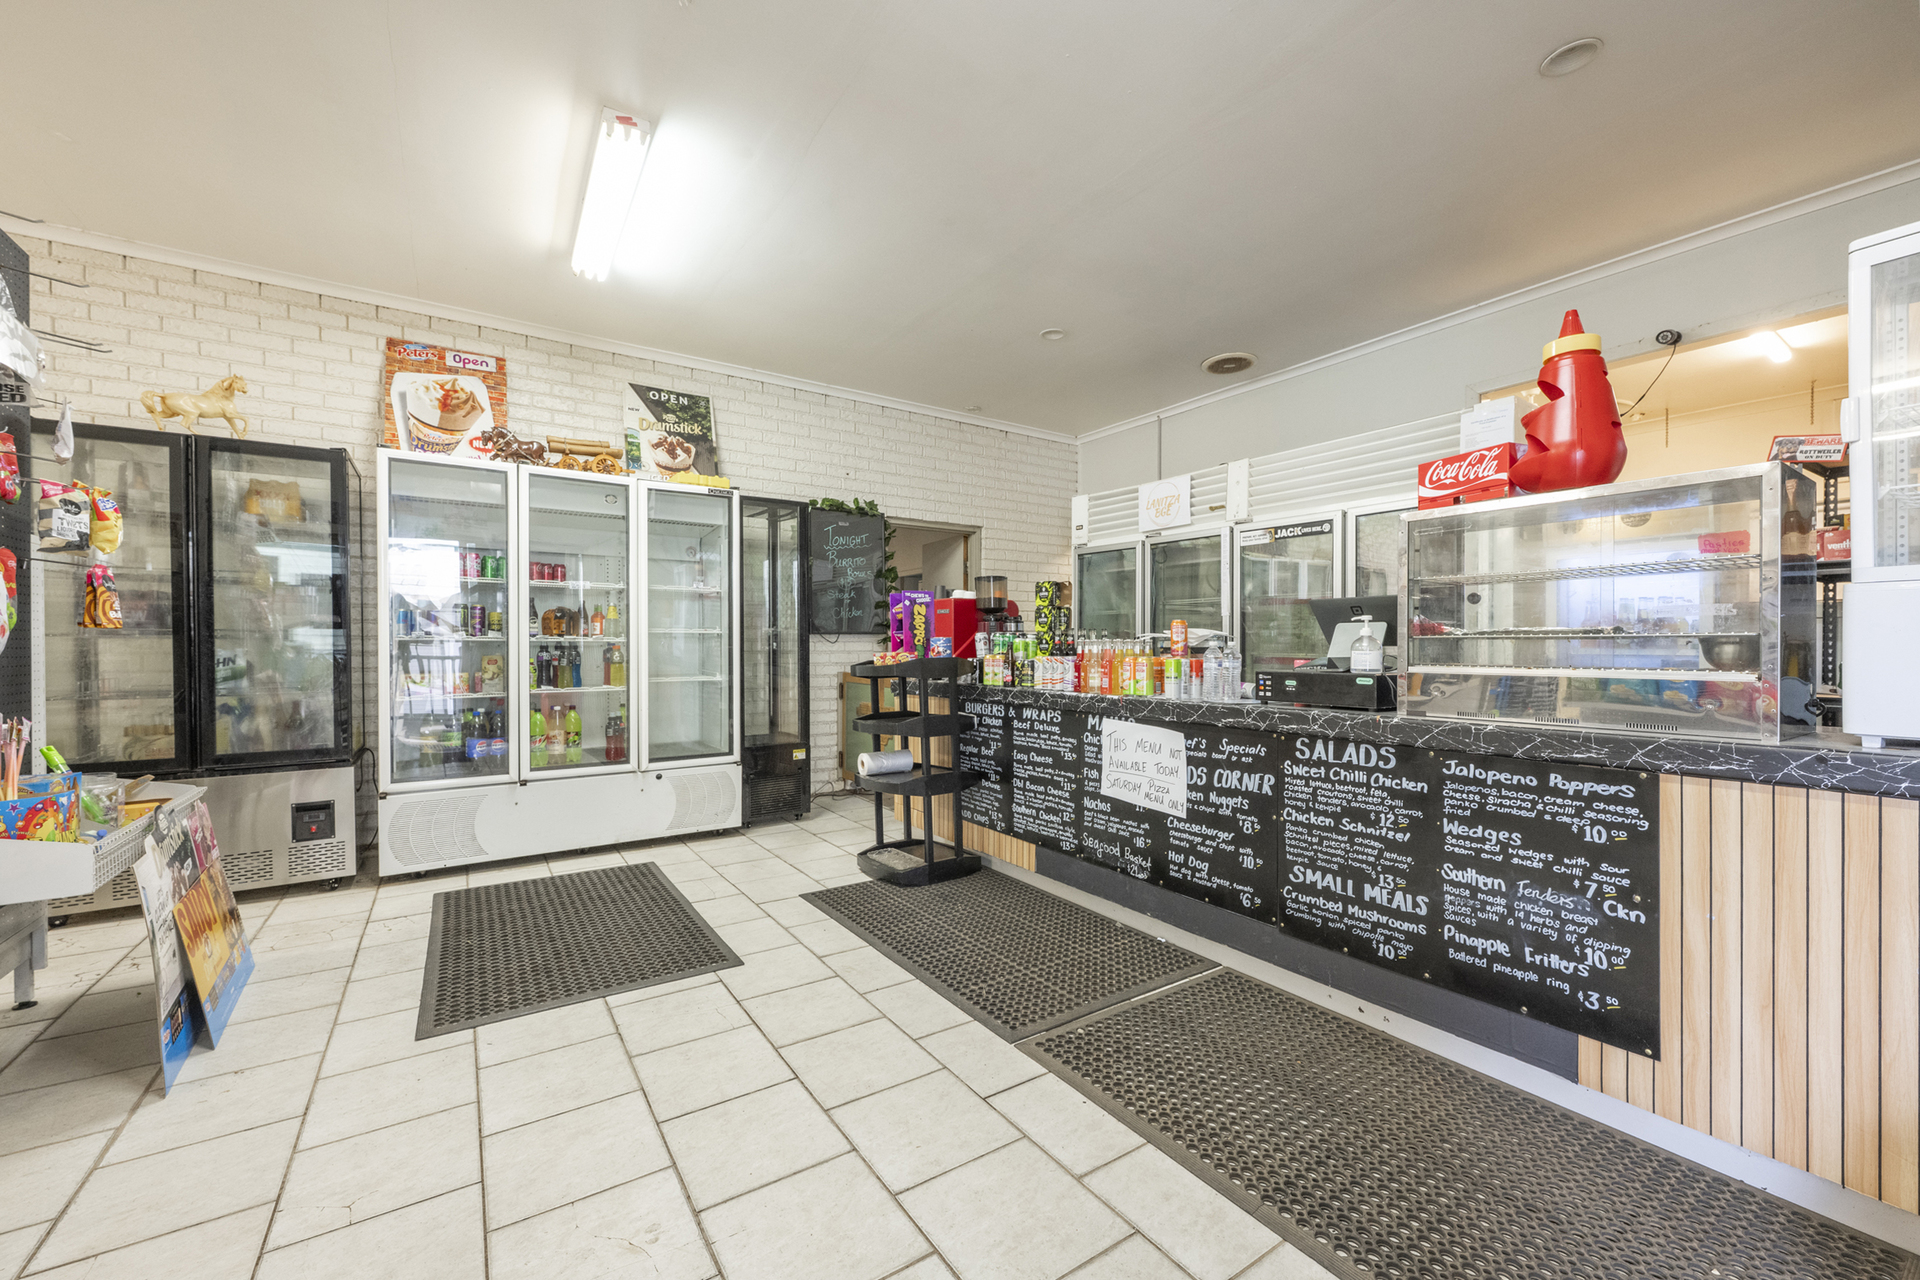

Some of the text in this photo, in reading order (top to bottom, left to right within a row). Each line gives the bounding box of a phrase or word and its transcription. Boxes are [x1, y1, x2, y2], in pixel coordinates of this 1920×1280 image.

[396, 346, 438, 358] Peters
[453, 354, 488, 368] Open
[649, 390, 688, 406] OPEN
[638, 417, 702, 434] Drumstick
[1804, 438, 1844, 446] BEWARE
[1425, 446, 1504, 488] Coca-Cola
[824, 524, 869, 546] TONIGHT
[1275, 526, 1302, 538] JACK
[1703, 538, 1745, 548] Pasties
[826, 550, 866, 568] BURRITO
[827, 590, 856, 599] Steak
[832, 606, 863, 618] Chicken
[965, 701, 1062, 722] BURGERS & WRAPS
[982, 716, 1002, 726] Chicken
[1013, 720, 1060, 733] Beef Deluxe
[1107, 730, 1182, 760] THIS MENU NOT
[1219, 738, 1267, 756] Specials
[1295, 737, 1396, 769] SALADS
[1013, 750, 1028, 763] Easy
[1030, 752, 1053, 764] Cheese
[1109, 755, 1147, 772] AVAILABLE
[1084, 767, 1099, 779] Fish
[1213, 769, 1275, 796] CORNER
[1284, 760, 1428, 793] Sweet Chilli Chicken
[1284, 777, 1305, 786] Mixed
[1442, 760, 1636, 798] Jalopeno Poppers
[982, 779, 1001, 791] Deluxe
[1013, 778, 1023, 787] Dbl
[1026, 781, 1045, 792] Bacon
[1047, 786, 1070, 798] Cheese
[1106, 773, 1142, 795] SATURDAY
[1147, 778, 1170, 795] PIZZA
[1284, 784, 1313, 793] roasted
[1356, 795, 1382, 805] sweet
[1083, 796, 1111, 812] Nachos
[1144, 791, 1185, 813] MENU ONLY
[1210, 791, 1249, 812] Nuggets
[1284, 798, 1342, 814] honey kewpie
[1443, 806, 1471, 817] fried
[1544, 795, 1585, 808] cream
[974, 813, 989, 824] CHIPS
[1012, 803, 1036, 816] Southern
[1039, 810, 1062, 824] Chicken
[1444, 799, 1590, 826] panko crumbed deep
[1582, 808, 1649, 831] seasoning
[1167, 816, 1235, 842] Cheeseburger
[1283, 807, 1411, 842] Chicken Schnitzel
[1443, 818, 1522, 846] Wedges
[1285, 823, 1385, 849] Panko crumbed chicken
[1083, 832, 1121, 857] Seafood
[1125, 847, 1152, 871] Basket
[1354, 845, 1378, 856] mixed
[1508, 847, 1554, 862] wedges
[1564, 857, 1590, 867] with
[1600, 863, 1630, 874] sour
[1168, 850, 1209, 875] Hot Dog
[1286, 853, 1339, 871] kewpie sauce
[1348, 859, 1372, 873] honey
[1444, 844, 1475, 855] cream
[1481, 852, 1503, 862] and
[1510, 857, 1544, 869] sweet
[1591, 872, 1631, 887] sauce
[1288, 865, 1429, 916] SMALL MEALS
[1440, 863, 1646, 924] Southern Tenders Ckn
[1283, 886, 1427, 935] Crumbed Mushrooms
[1443, 883, 1599, 926] House made chicken breast
[1285, 908, 1414, 951] crumbing with chipotle mayo
[1286, 900, 1309, 912] Garlic
[1343, 917, 1371, 930] spiced
[1377, 927, 1405, 940] panko
[1486, 904, 1507, 915] with
[1530, 913, 1560, 928] herbs
[1564, 923, 1589, 934] and
[1477, 910, 1631, 959] with a variety of dipping
[1443, 924, 1590, 977] Pinapple Fritters
[1448, 948, 1570, 995] Battered pineapple ring
